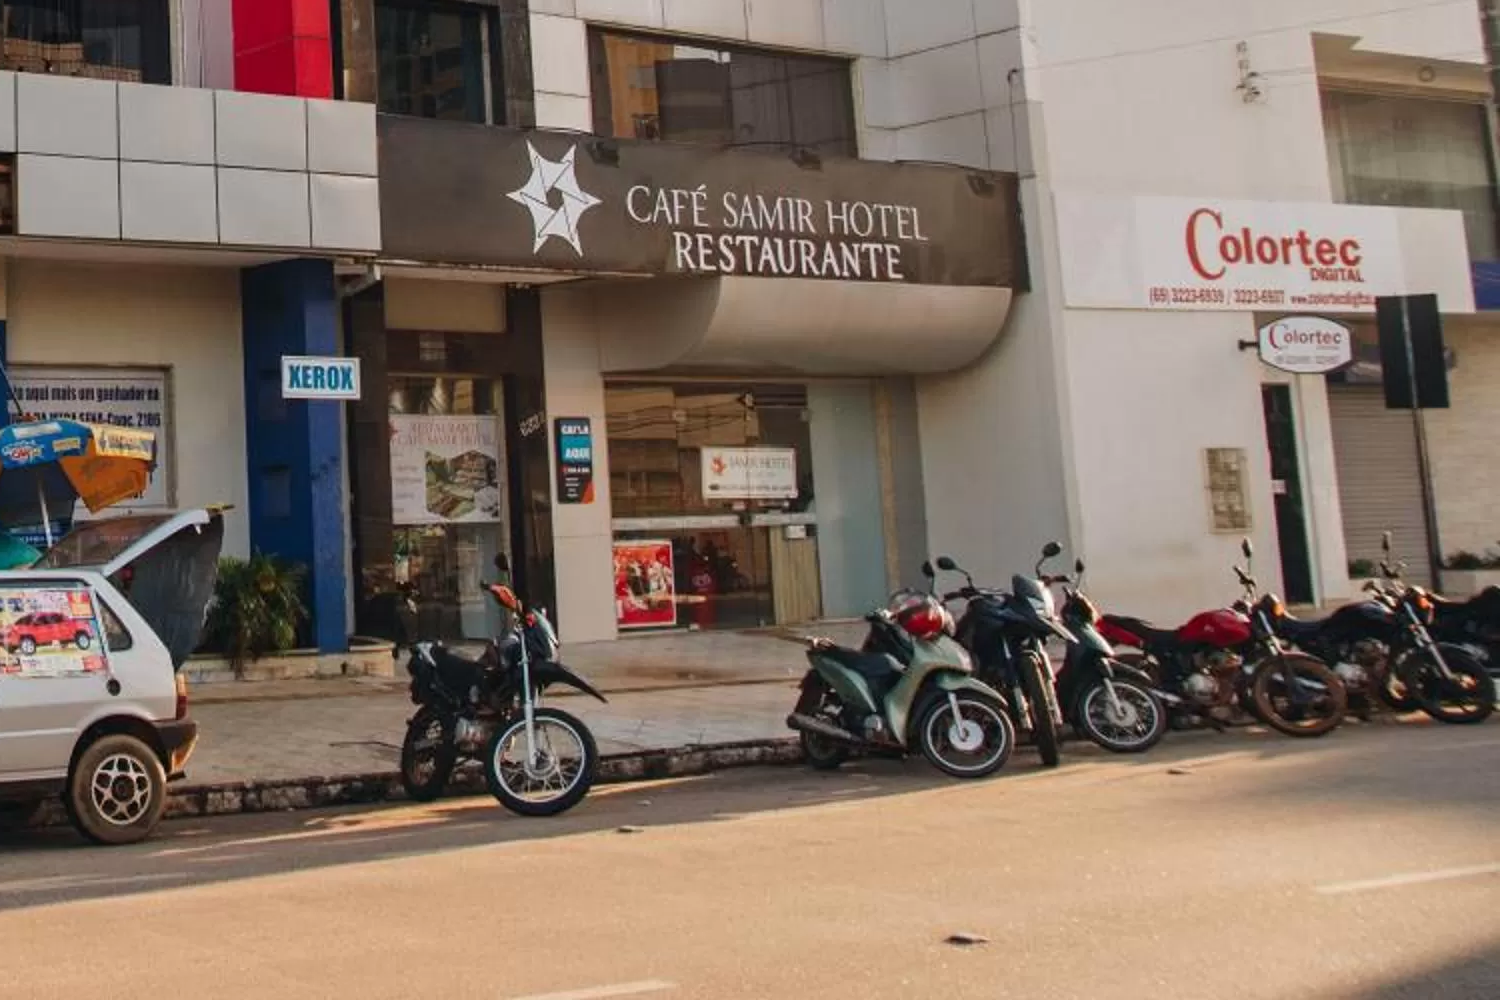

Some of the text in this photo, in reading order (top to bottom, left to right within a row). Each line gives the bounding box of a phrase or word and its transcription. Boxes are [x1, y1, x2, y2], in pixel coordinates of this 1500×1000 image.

[626, 184, 929, 241] CAFÉ SAMIR HOTEL
[672, 231, 905, 279] RESTAURANTE
[1185, 207, 1362, 281] Colortec
[1310, 267, 1365, 283] DIGITAL
[1268, 323, 1342, 350] Colortec
[288, 364, 354, 391] XEROX
